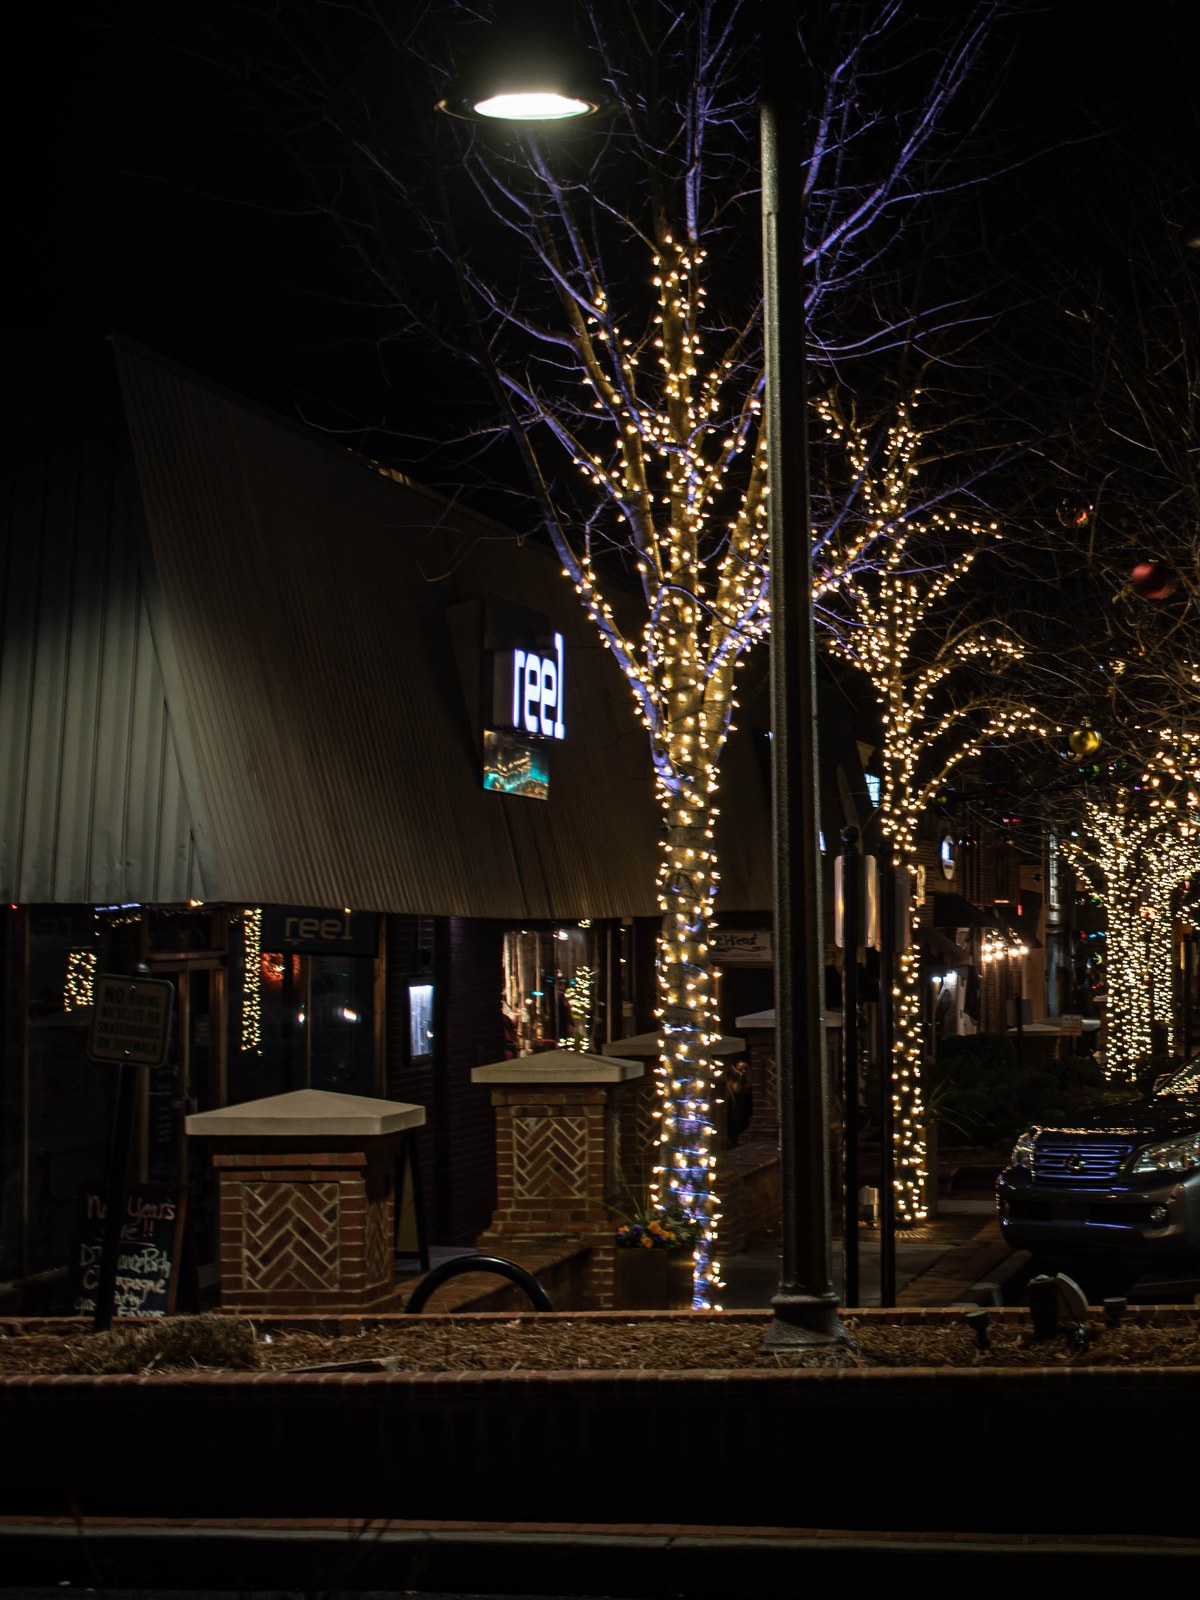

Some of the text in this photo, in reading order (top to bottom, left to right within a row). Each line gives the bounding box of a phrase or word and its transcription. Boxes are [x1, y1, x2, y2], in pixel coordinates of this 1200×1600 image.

[511, 631, 565, 741] reel
[284, 911, 353, 942] reel
[106, 987, 125, 1004] NO
[102, 1005, 143, 1021] BICYCLES
[97, 1021, 160, 1038] SKATEBOARDS
